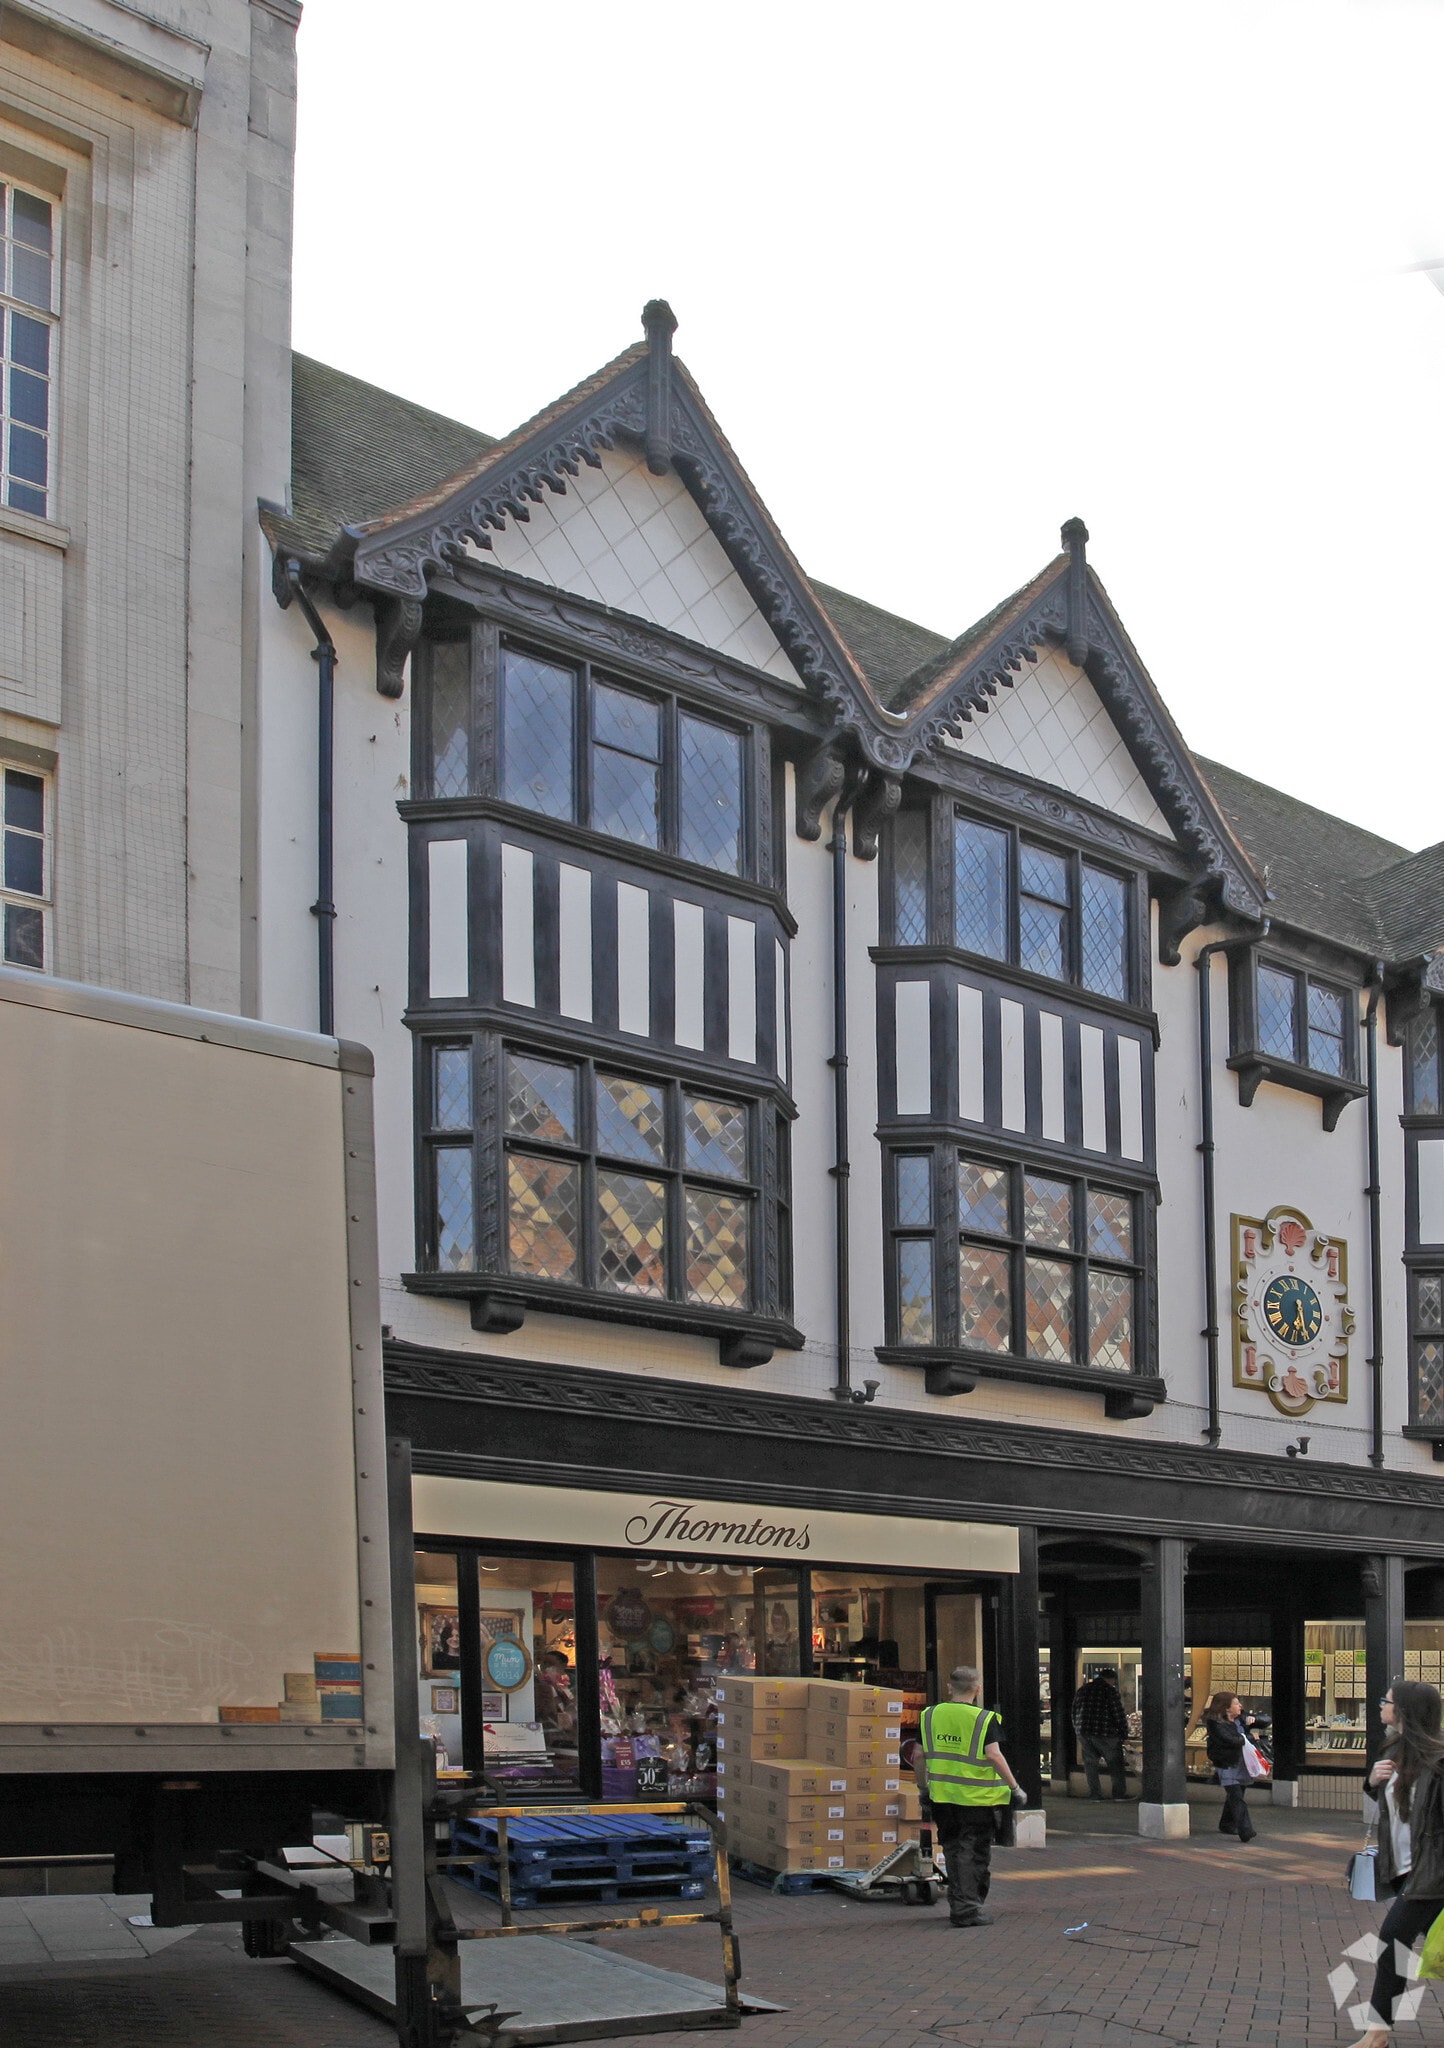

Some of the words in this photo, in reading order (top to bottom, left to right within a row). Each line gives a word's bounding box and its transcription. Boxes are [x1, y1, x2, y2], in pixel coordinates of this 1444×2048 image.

[624, 1500, 811, 1550] Thorntons
[493, 1653, 520, 1665] Mum
[495, 1670, 521, 1681] 2014
[936, 1732, 962, 1744] EXTRA
